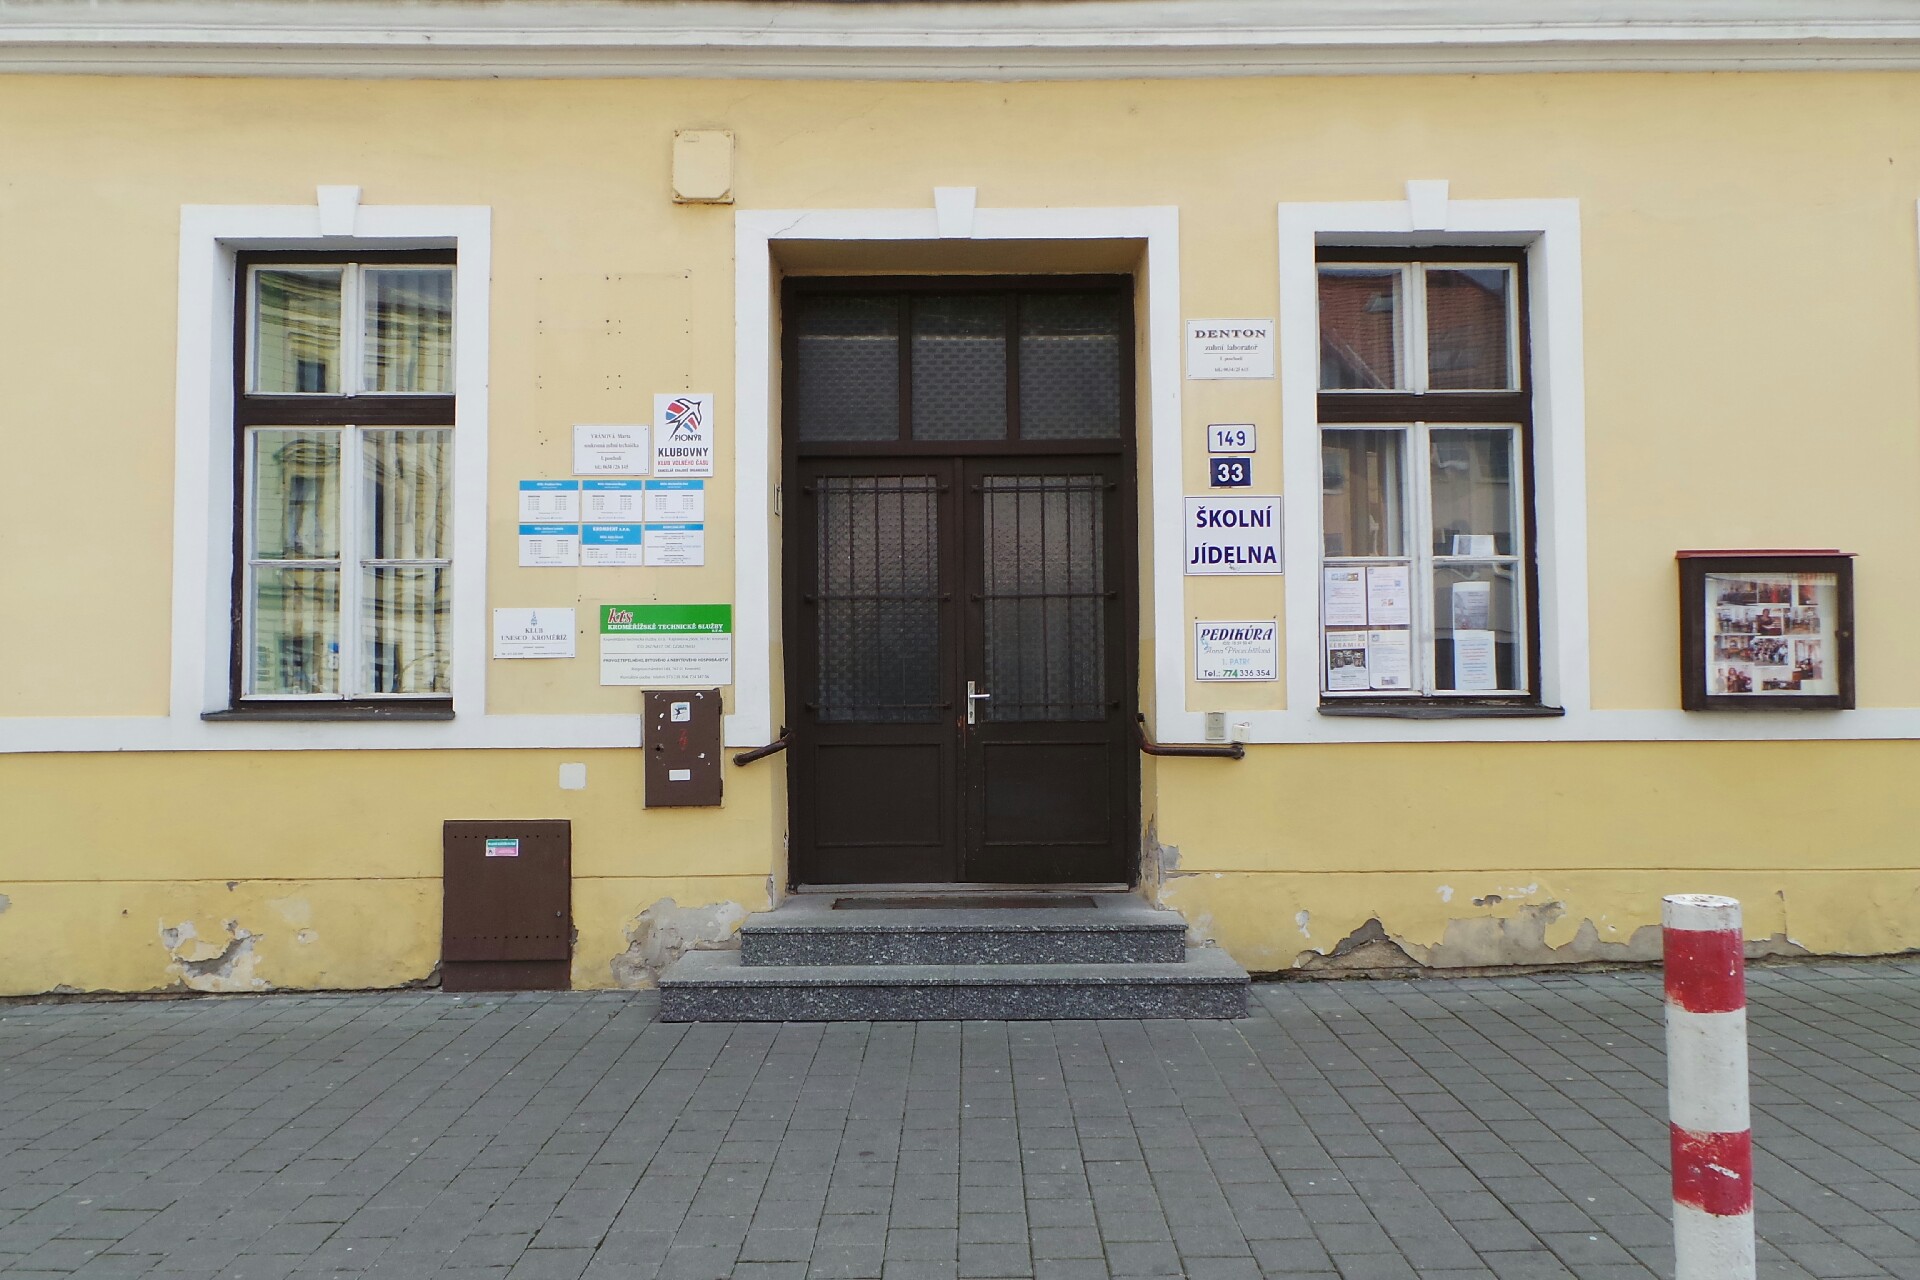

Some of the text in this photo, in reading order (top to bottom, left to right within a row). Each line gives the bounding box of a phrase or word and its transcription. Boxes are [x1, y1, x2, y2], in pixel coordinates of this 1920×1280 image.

[1194, 329, 1267, 339] DENTON
[674, 433, 702, 442] PIONÝR
[1216, 430, 1246, 447] 149
[657, 447, 709, 457] KLUBOVNY
[1217, 463, 1244, 482] 33
[1196, 506, 1272, 528] ŠKOLNÍ
[1190, 542, 1278, 565] JÍDELNA
[608, 607, 634, 624] kts
[607, 622, 724, 630] KROMĚŘÍŽSKÉ TECHNICKÉ SLUŽBY
[1201, 625, 1273, 641] PEDIKÚRA
[1222, 669, 1239, 678] 774
[1239, 669, 1254, 677] 336
[1255, 669, 1271, 677] 354
